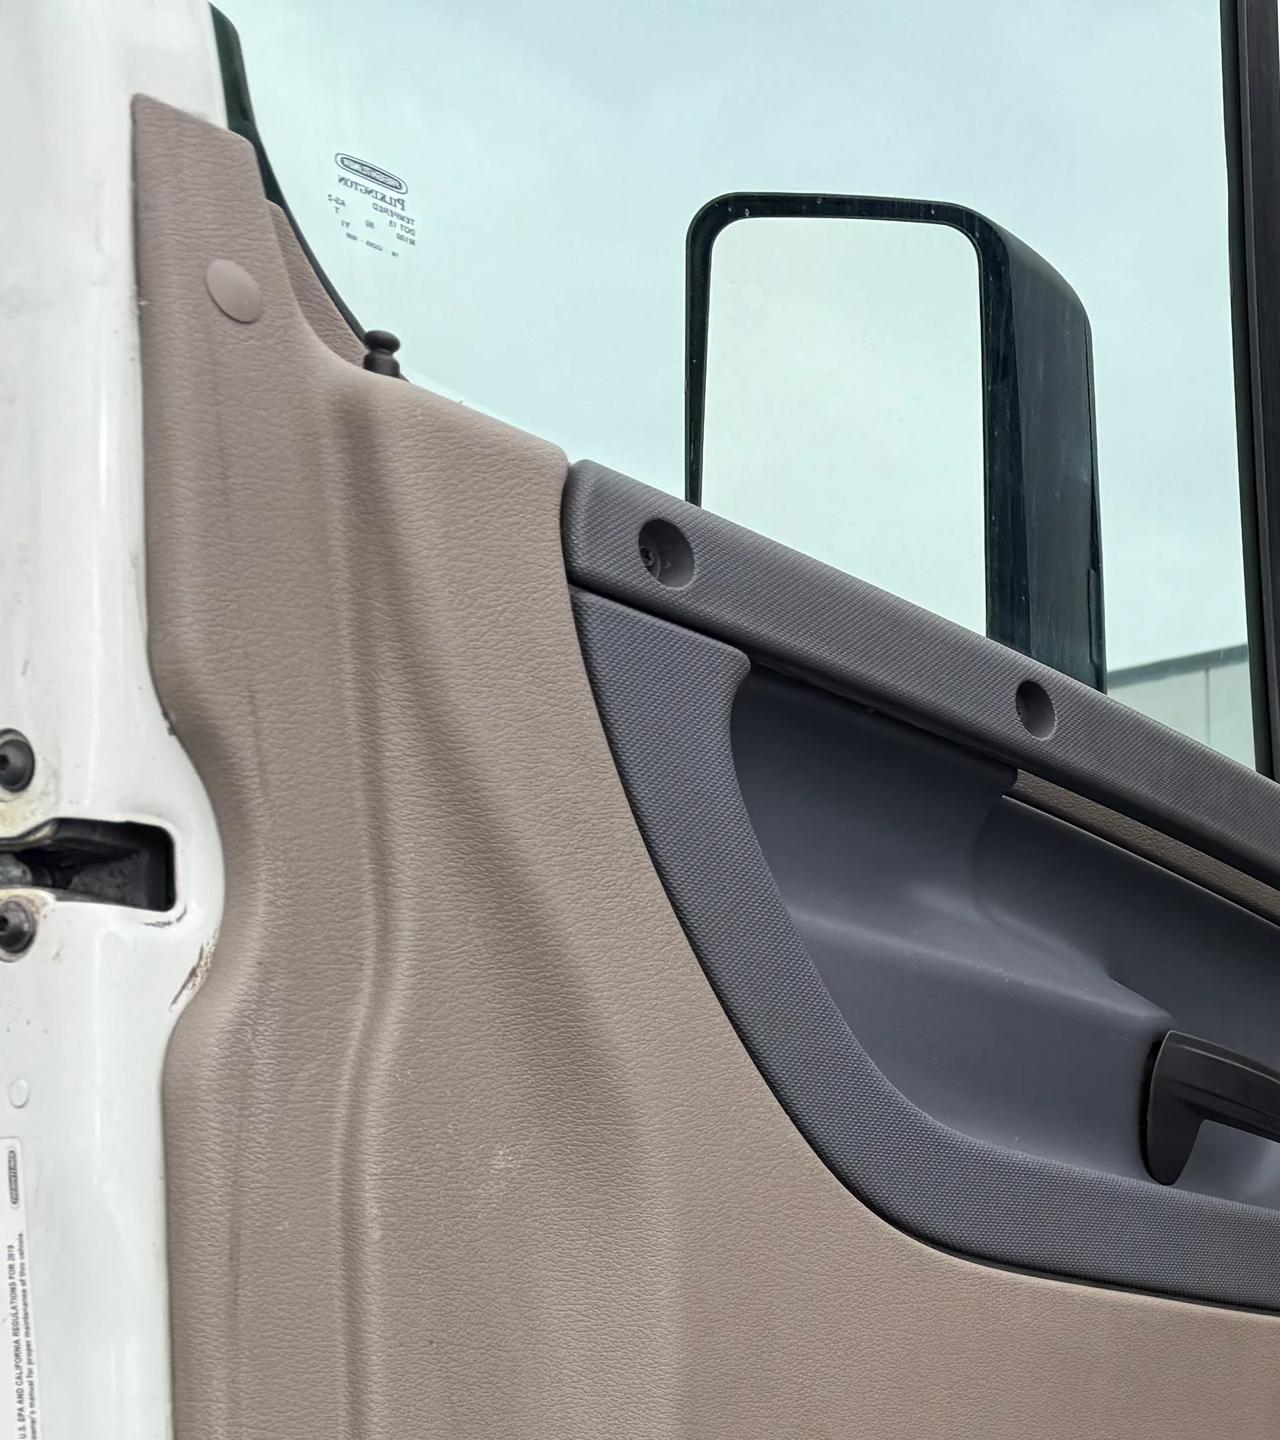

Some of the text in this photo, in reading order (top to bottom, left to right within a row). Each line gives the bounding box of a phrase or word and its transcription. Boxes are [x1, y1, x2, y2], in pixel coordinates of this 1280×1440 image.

[9, 1281, 20, 1337] REGULATIONS
[20, 1288, 31, 1338] maintenance
[12, 1339, 24, 1387] CALIFORNIA
[24, 1340, 35, 1366] proper
[15, 1387, 24, 1405] AND
[26, 1380, 35, 1408] manual
[16, 1406, 26, 1423] EPA
